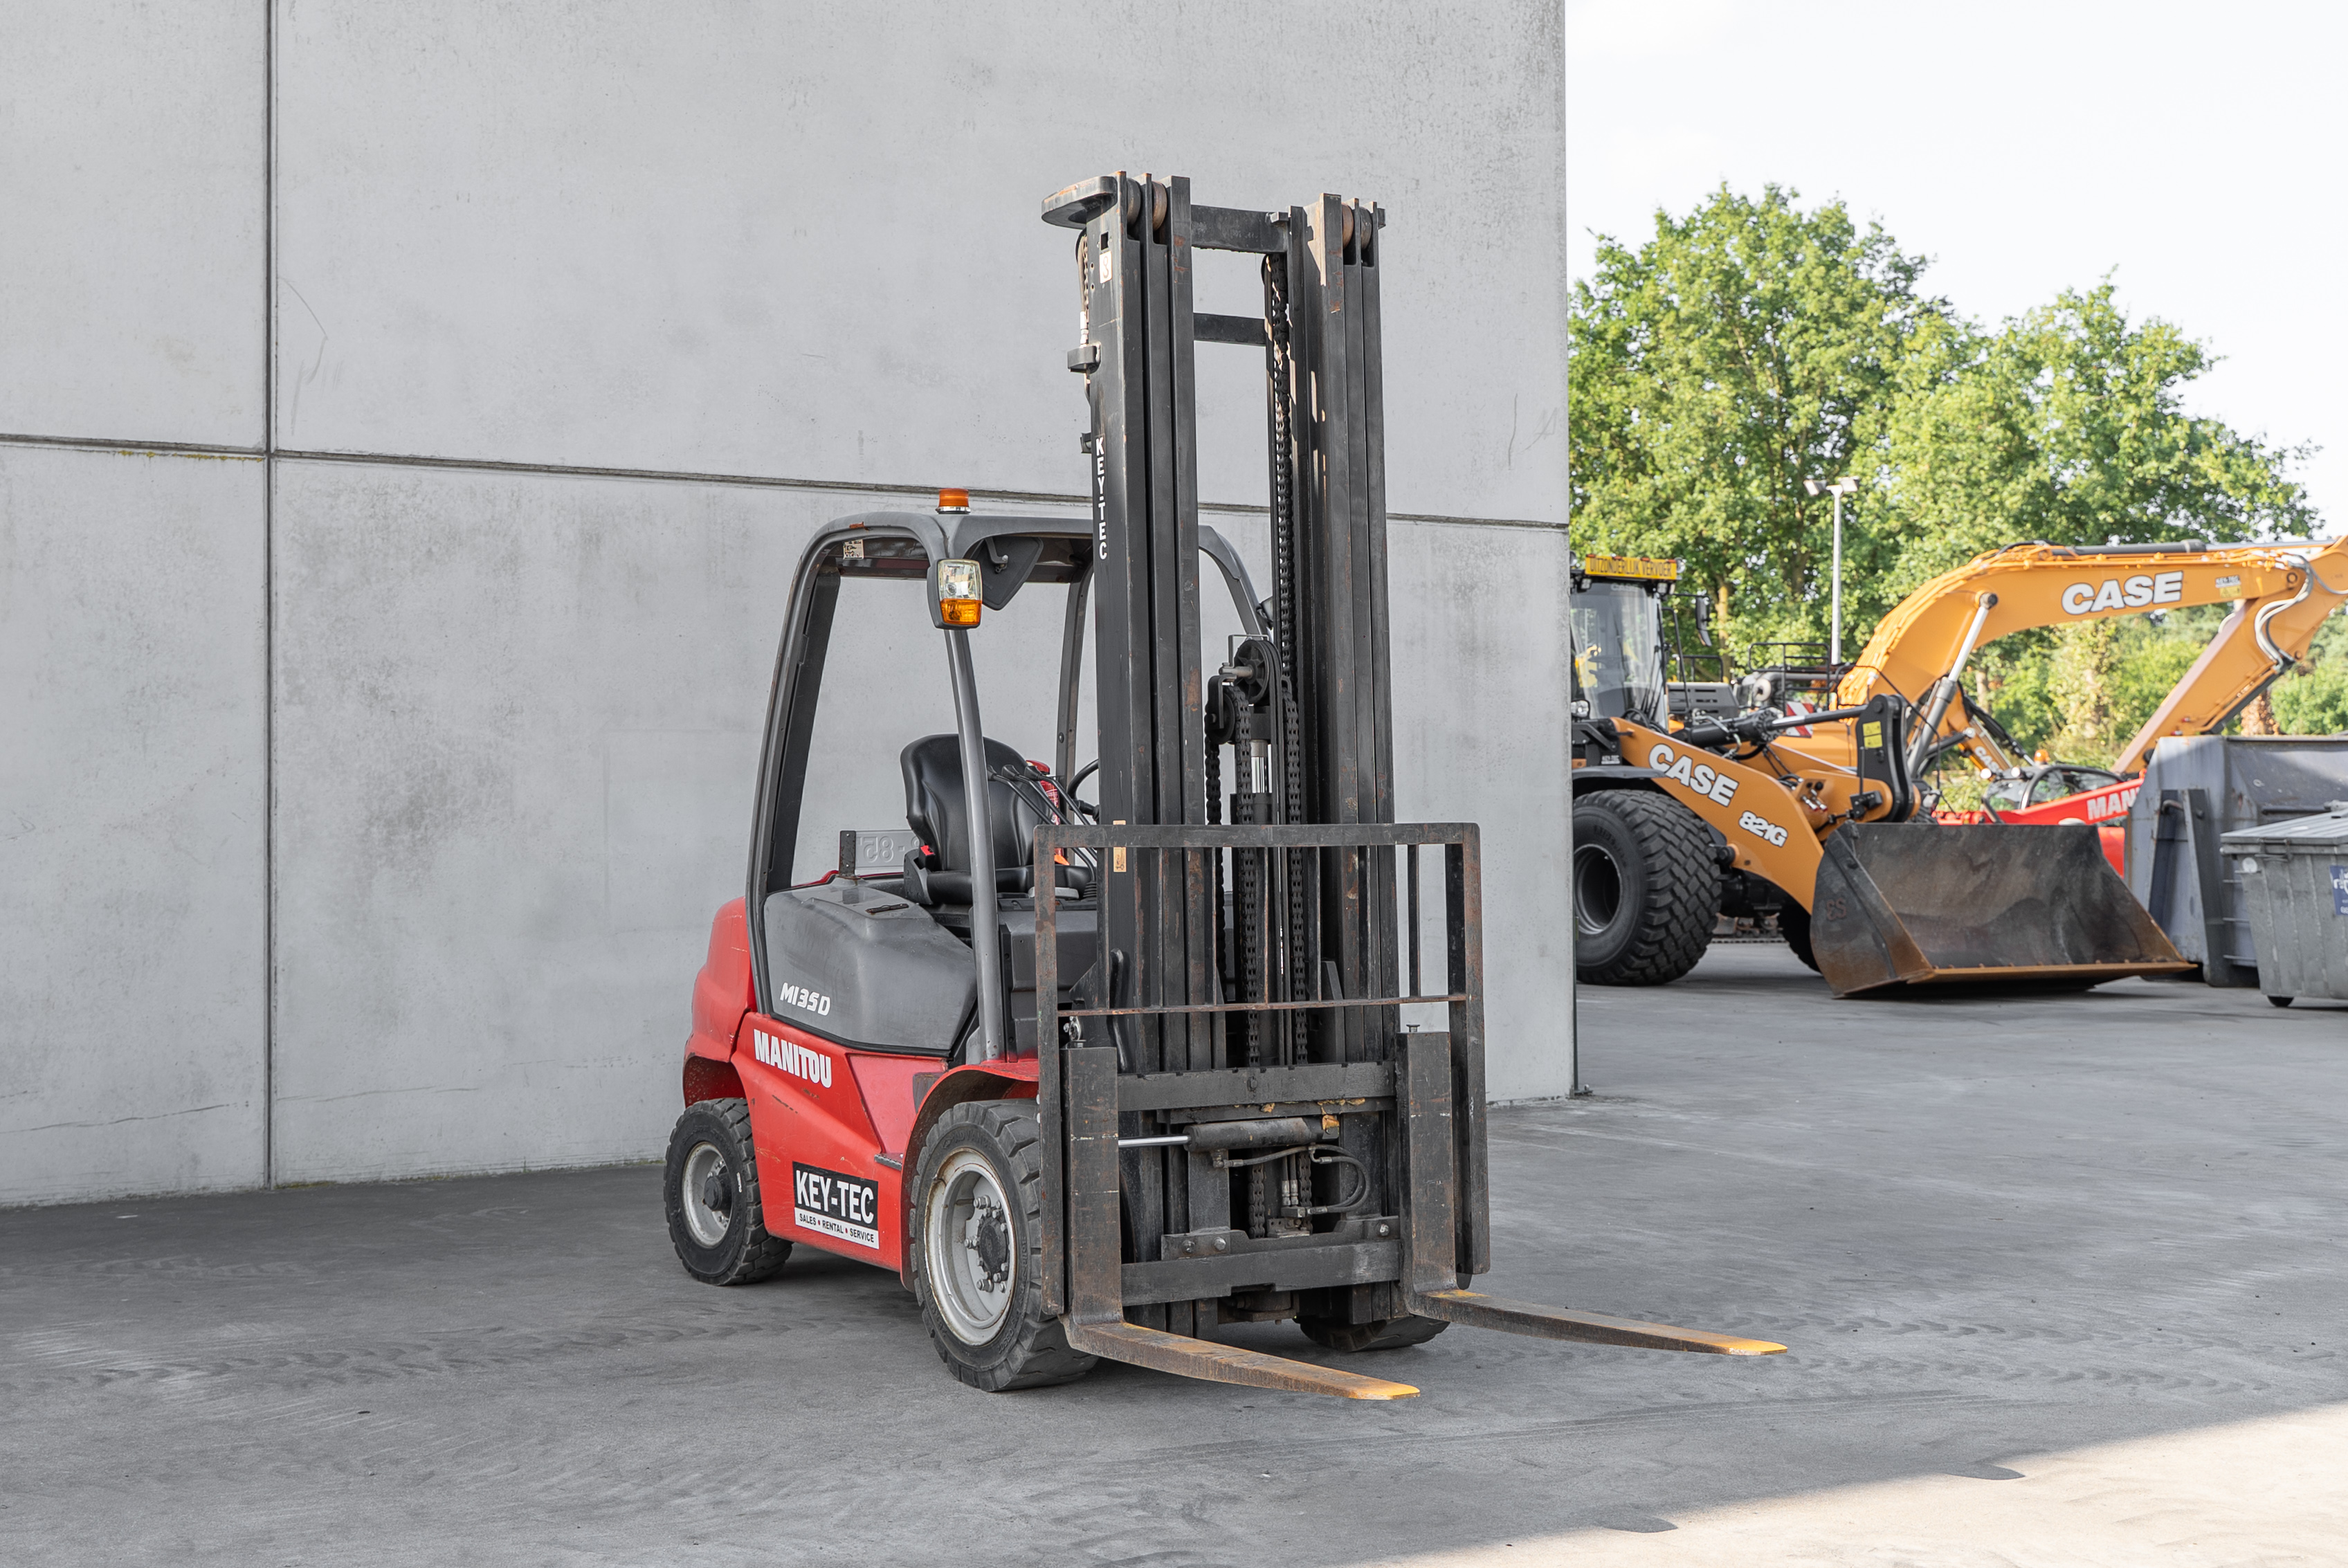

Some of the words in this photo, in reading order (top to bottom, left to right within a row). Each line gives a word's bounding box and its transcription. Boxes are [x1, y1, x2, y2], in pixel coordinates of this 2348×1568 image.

[1095, 437, 1107, 560] KEY-TEC
[1641, 561, 1672, 577] VERVOER
[2062, 570, 2184, 615] CASE
[1648, 743, 1739, 807] CASE
[1974, 746, 2003, 774] CAS
[1738, 811, 1788, 848] 821G
[754, 1028, 832, 1088] MANITOU
[796, 1170, 874, 1224] KEY-TEC
[799, 1213, 817, 1225] SALES
[822, 1220, 844, 1234] RENTAL
[849, 1228, 874, 1243] SERVICE
